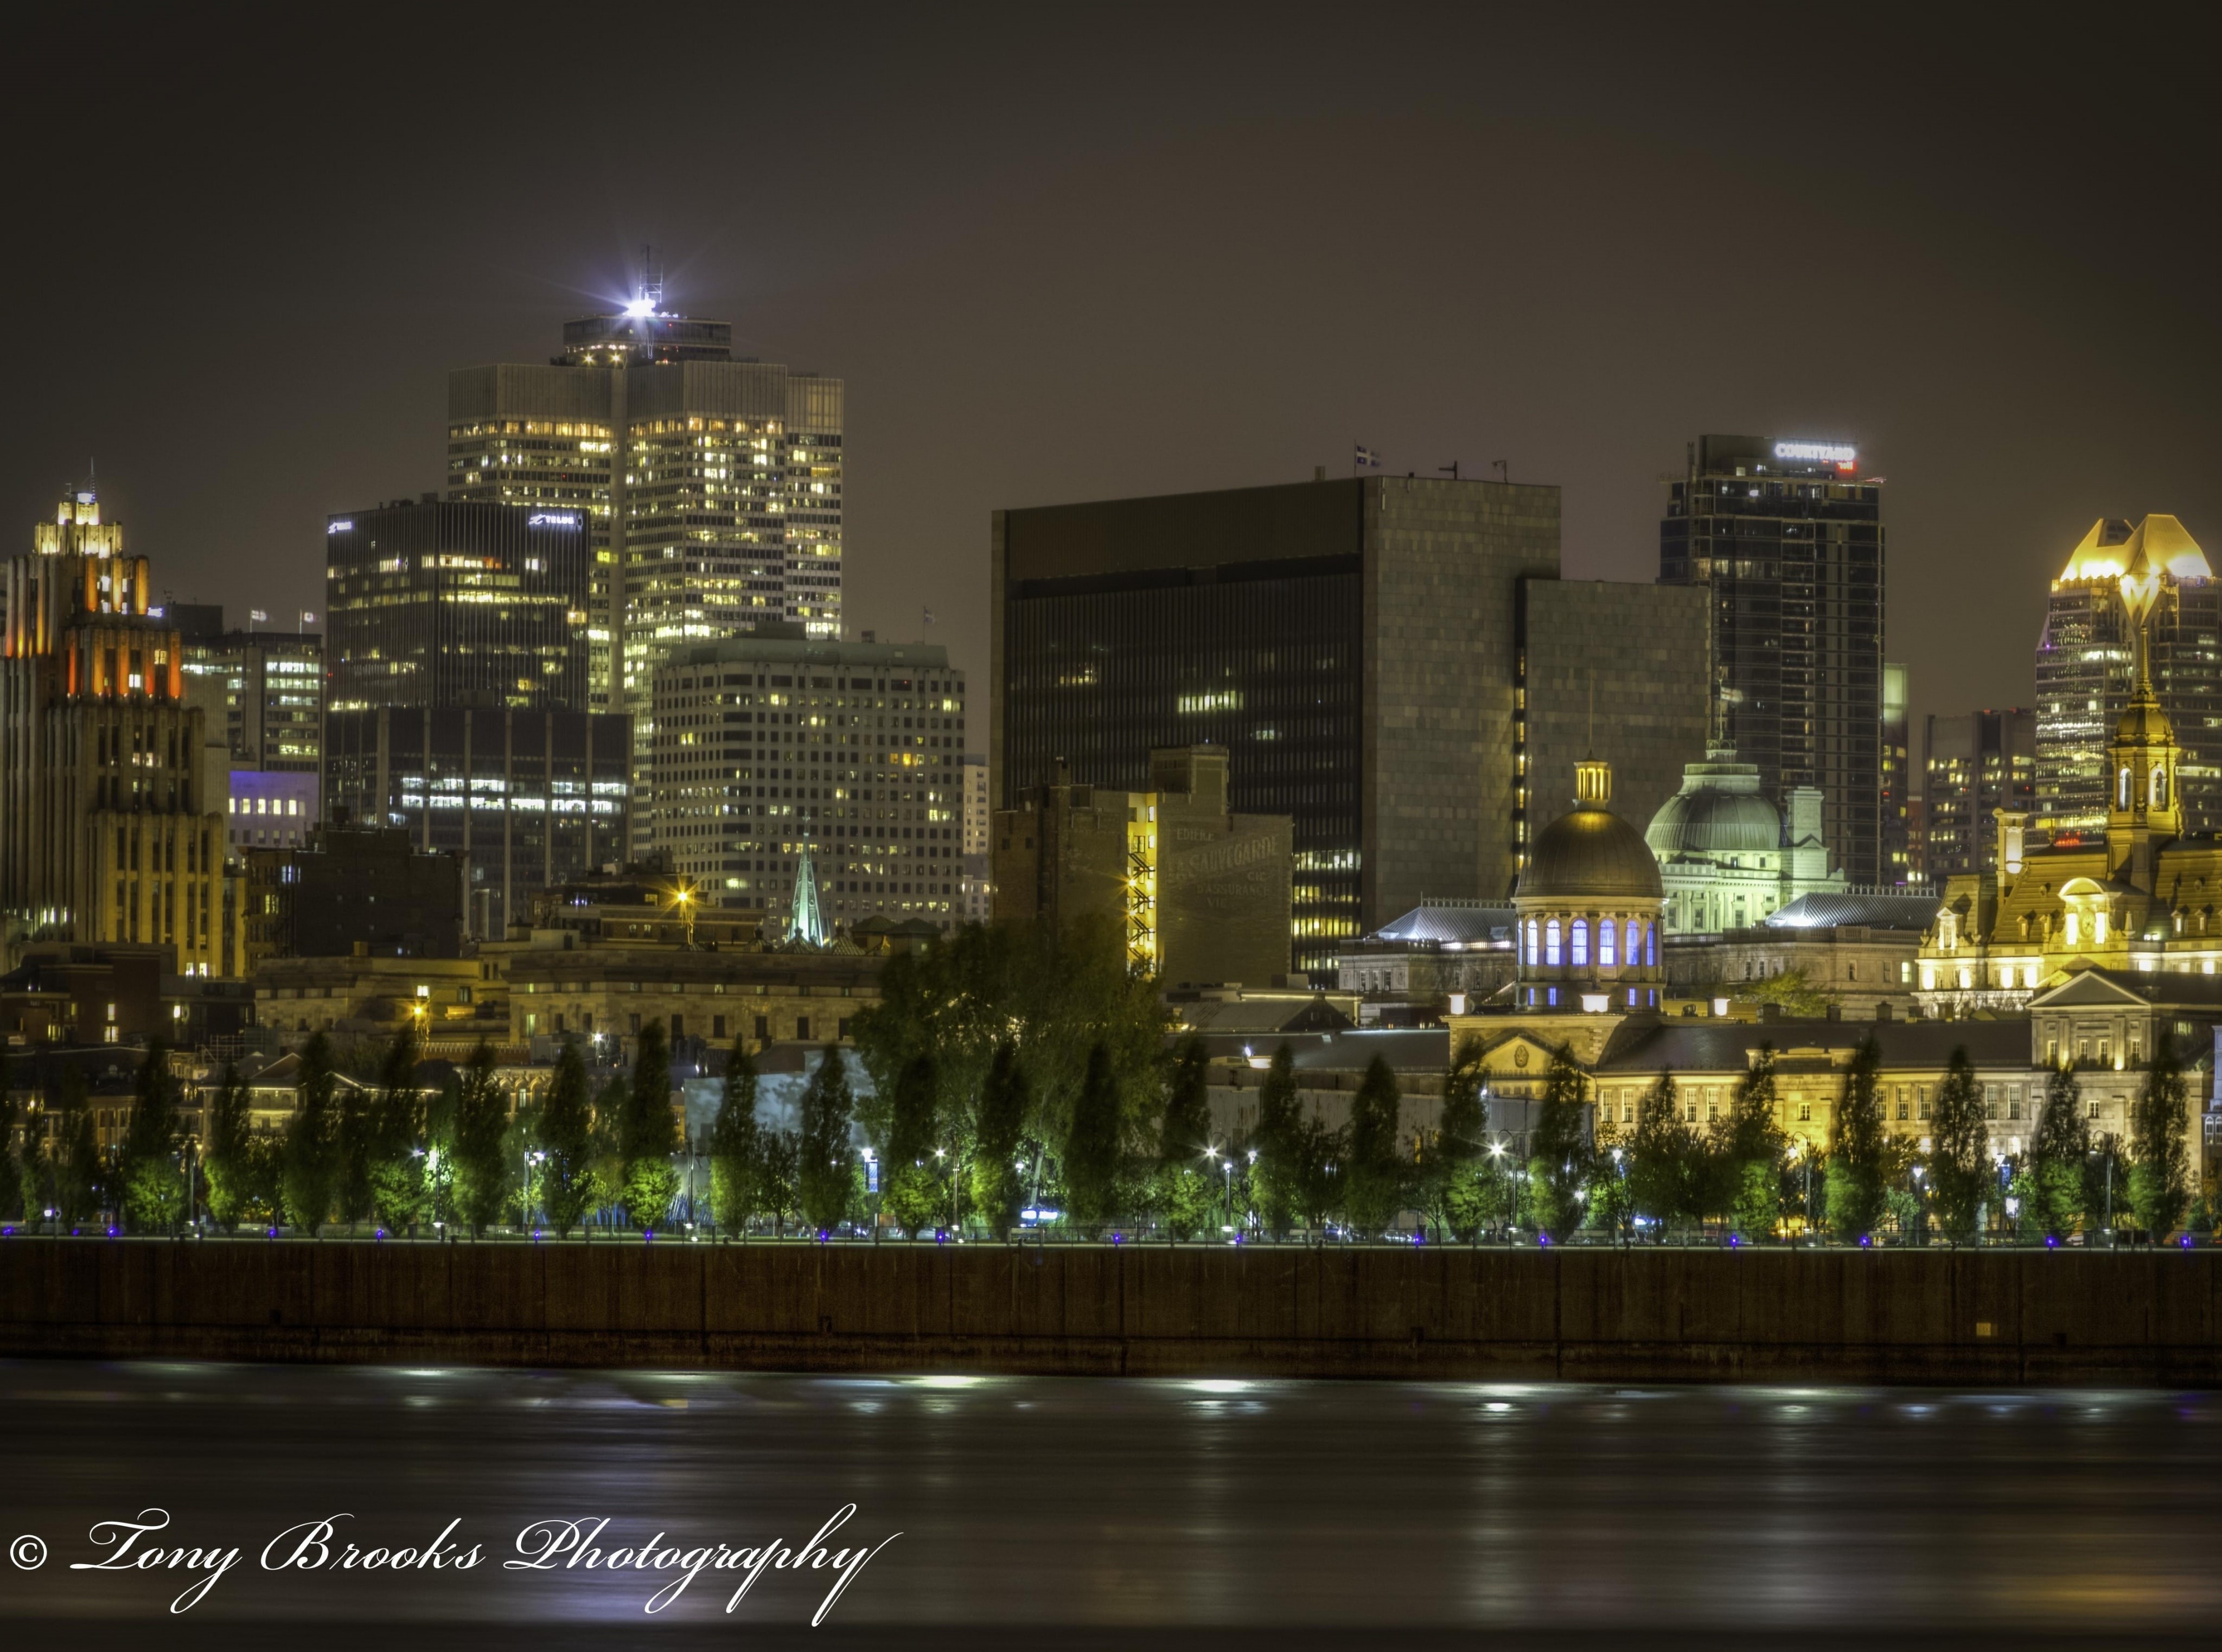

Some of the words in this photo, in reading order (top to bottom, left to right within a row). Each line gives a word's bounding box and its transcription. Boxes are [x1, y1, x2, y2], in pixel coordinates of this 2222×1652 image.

[545, 515, 574, 524] TELUS
[1189, 835, 1278, 871] SAUVEGARDE
[1206, 897, 1227, 908] VIE
